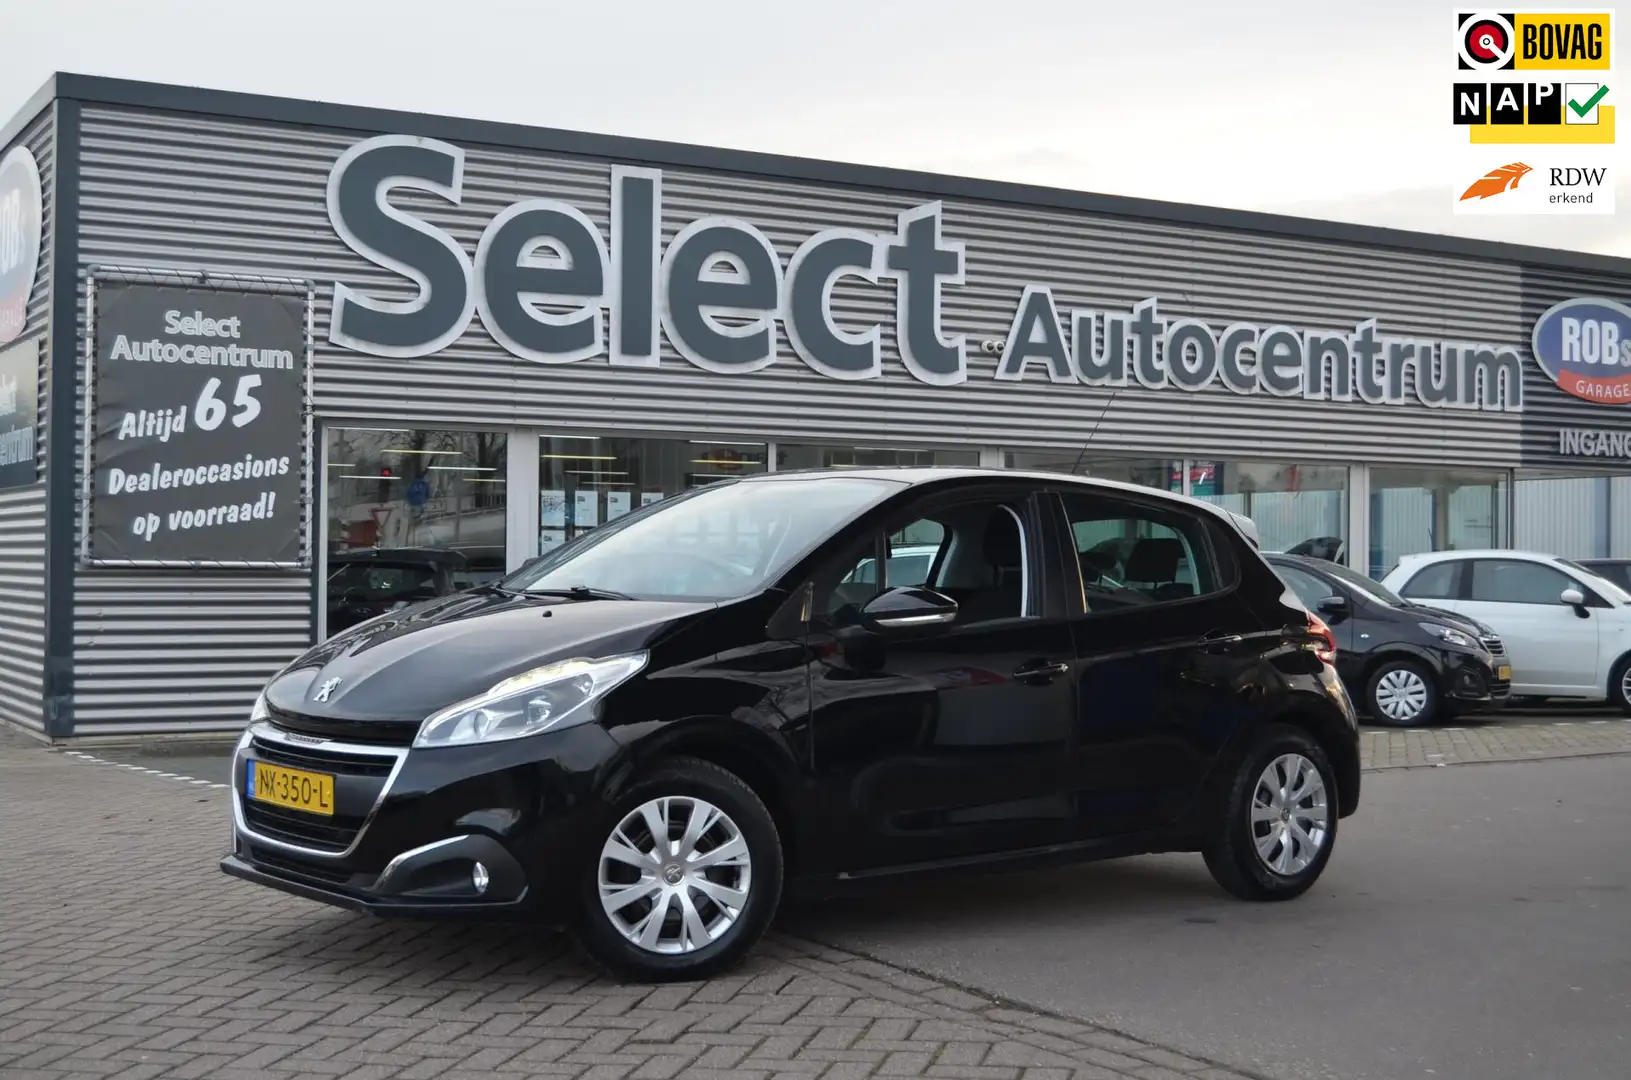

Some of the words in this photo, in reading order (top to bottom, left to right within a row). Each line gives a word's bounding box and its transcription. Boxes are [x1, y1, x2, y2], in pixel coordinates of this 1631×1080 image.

[327, 134, 966, 386] Select
[994, 284, 1523, 412] Autocentrum
[165, 310, 241, 338] Select
[110, 335, 294, 369] Autocentrum
[118, 405, 187, 443] Altijd
[194, 374, 262, 431] 65
[1575, 379, 1631, 398] GARAGE
[108, 454, 290, 495] Dealeroccasions
[132, 513, 160, 542] op
[168, 491, 276, 531] voorraad!
[259, 768, 329, 808] NX-350-L
